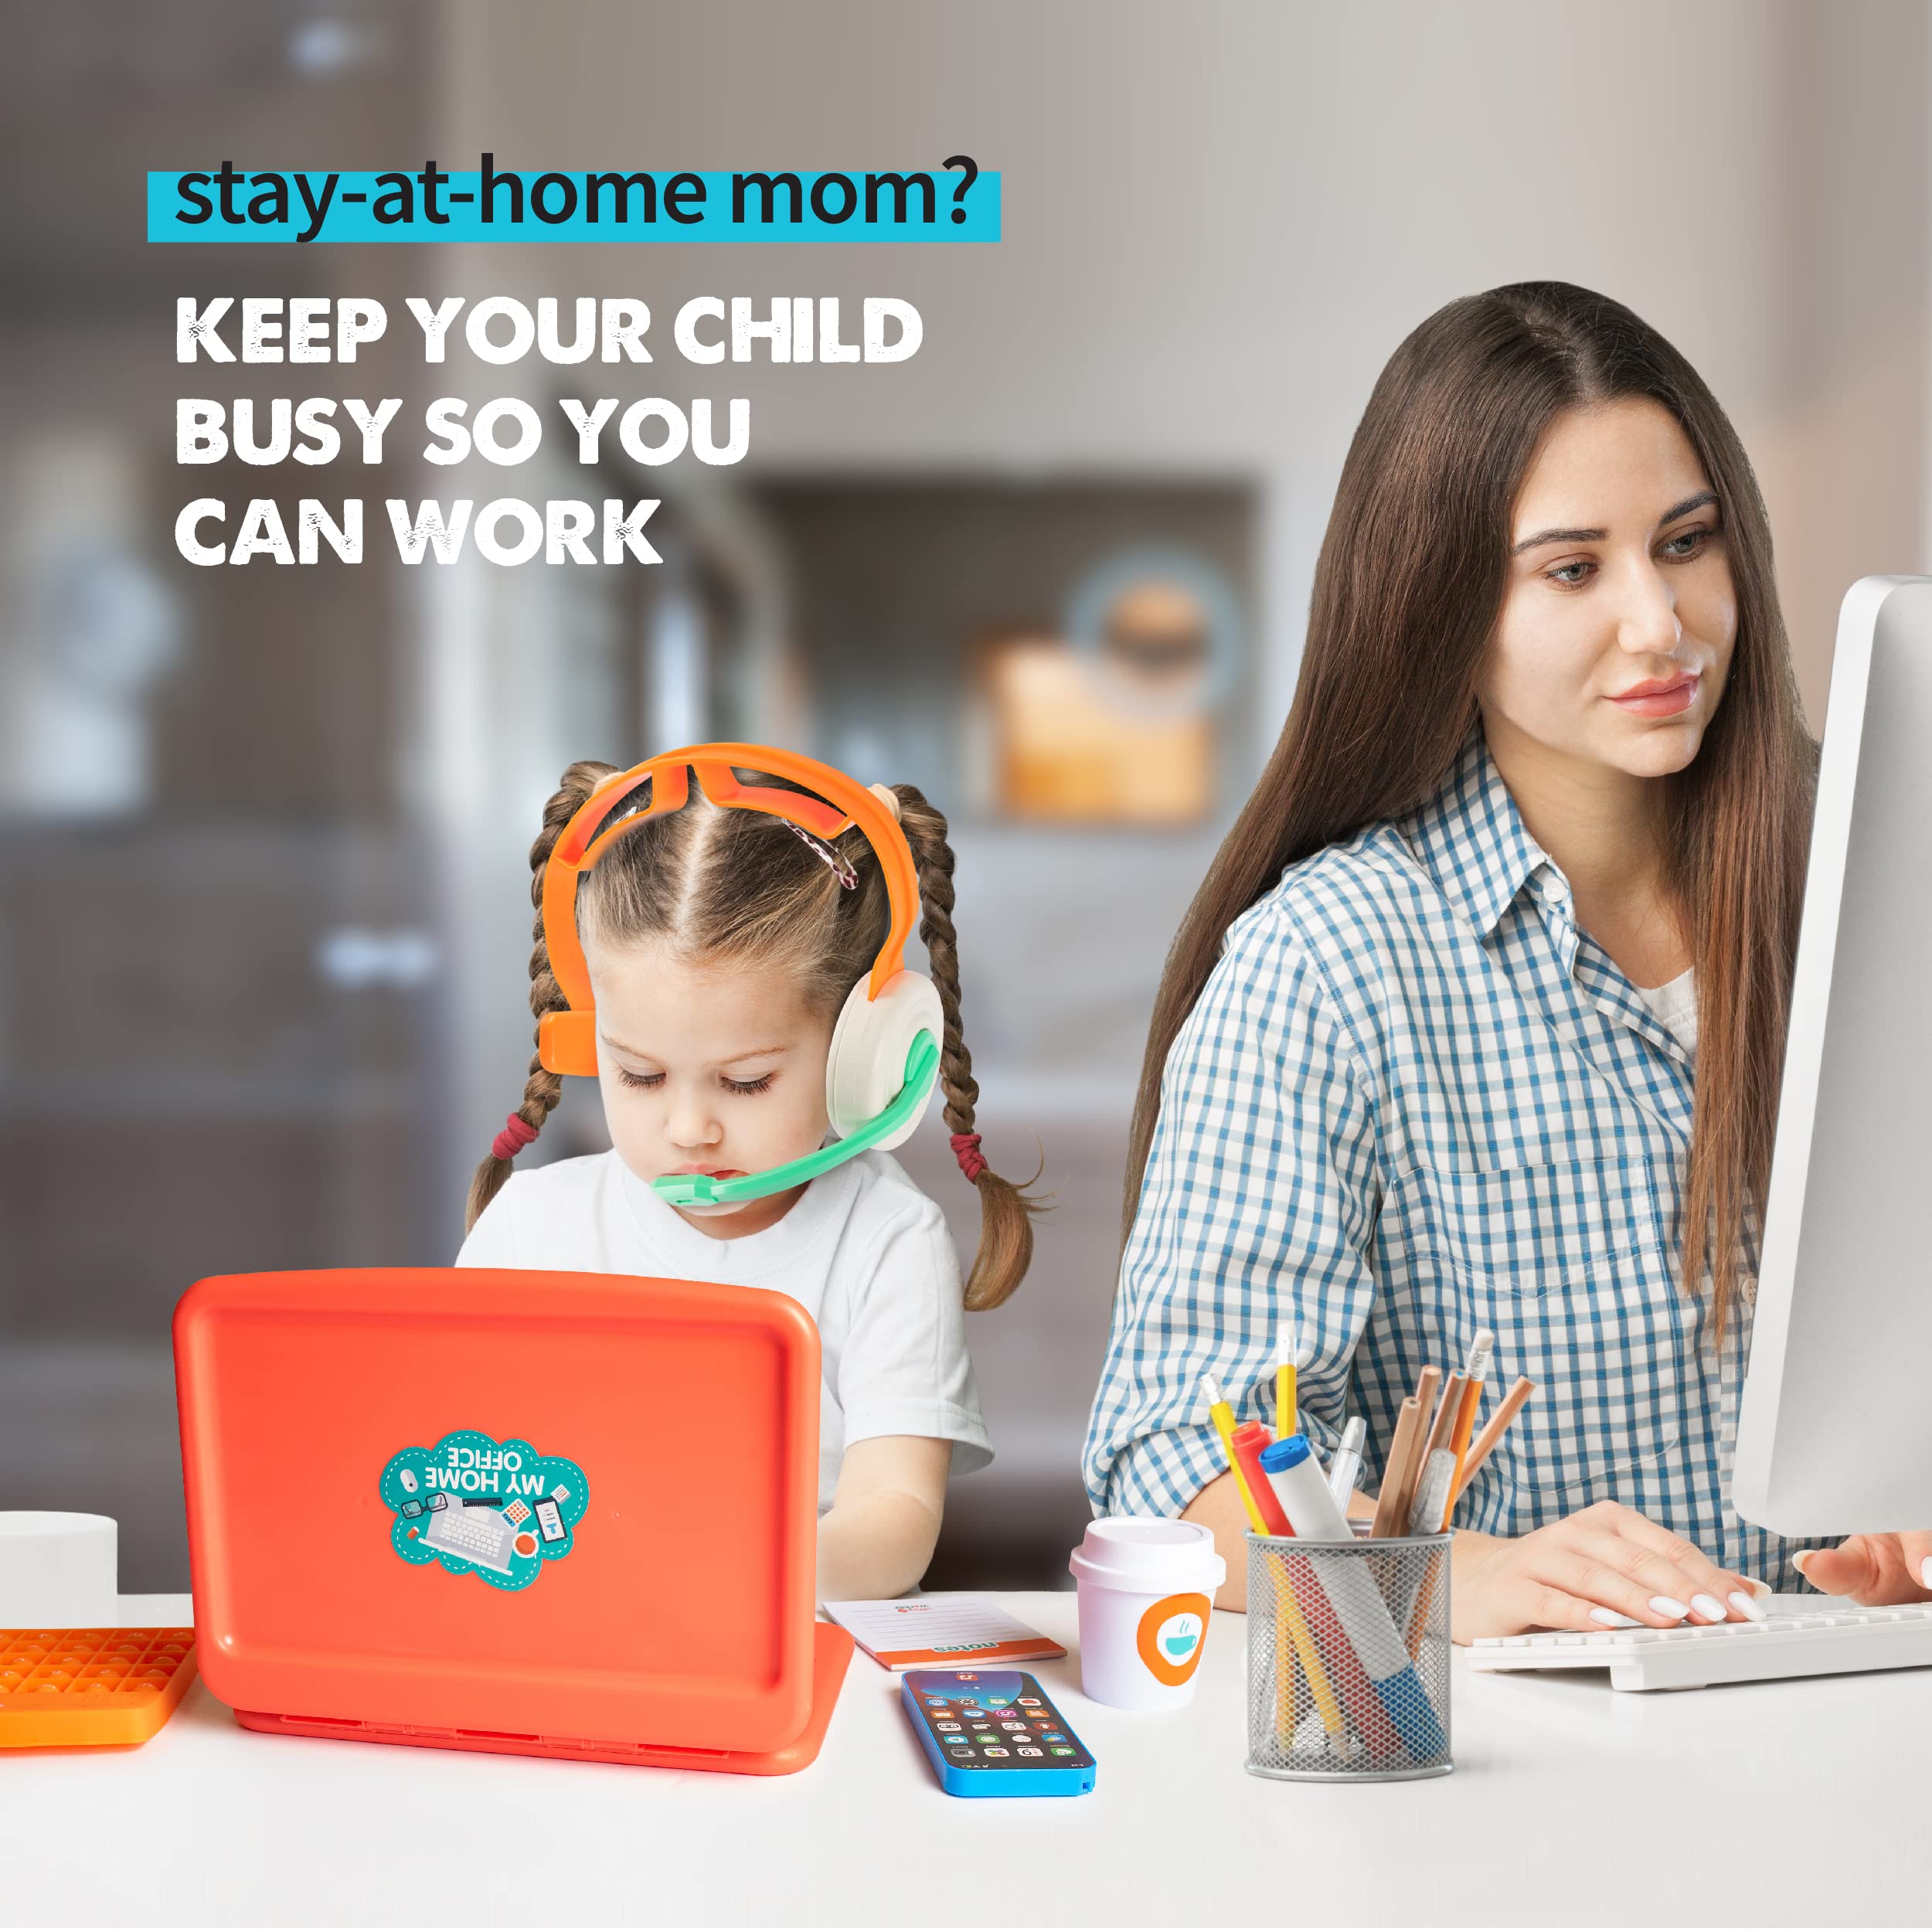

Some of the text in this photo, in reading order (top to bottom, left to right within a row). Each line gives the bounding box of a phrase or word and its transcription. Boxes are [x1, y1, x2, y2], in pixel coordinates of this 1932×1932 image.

[447, 1447, 522, 1471] OFFICE
[425, 1467, 545, 1495] MY HOME
[933, 1641, 998, 1651] notes
